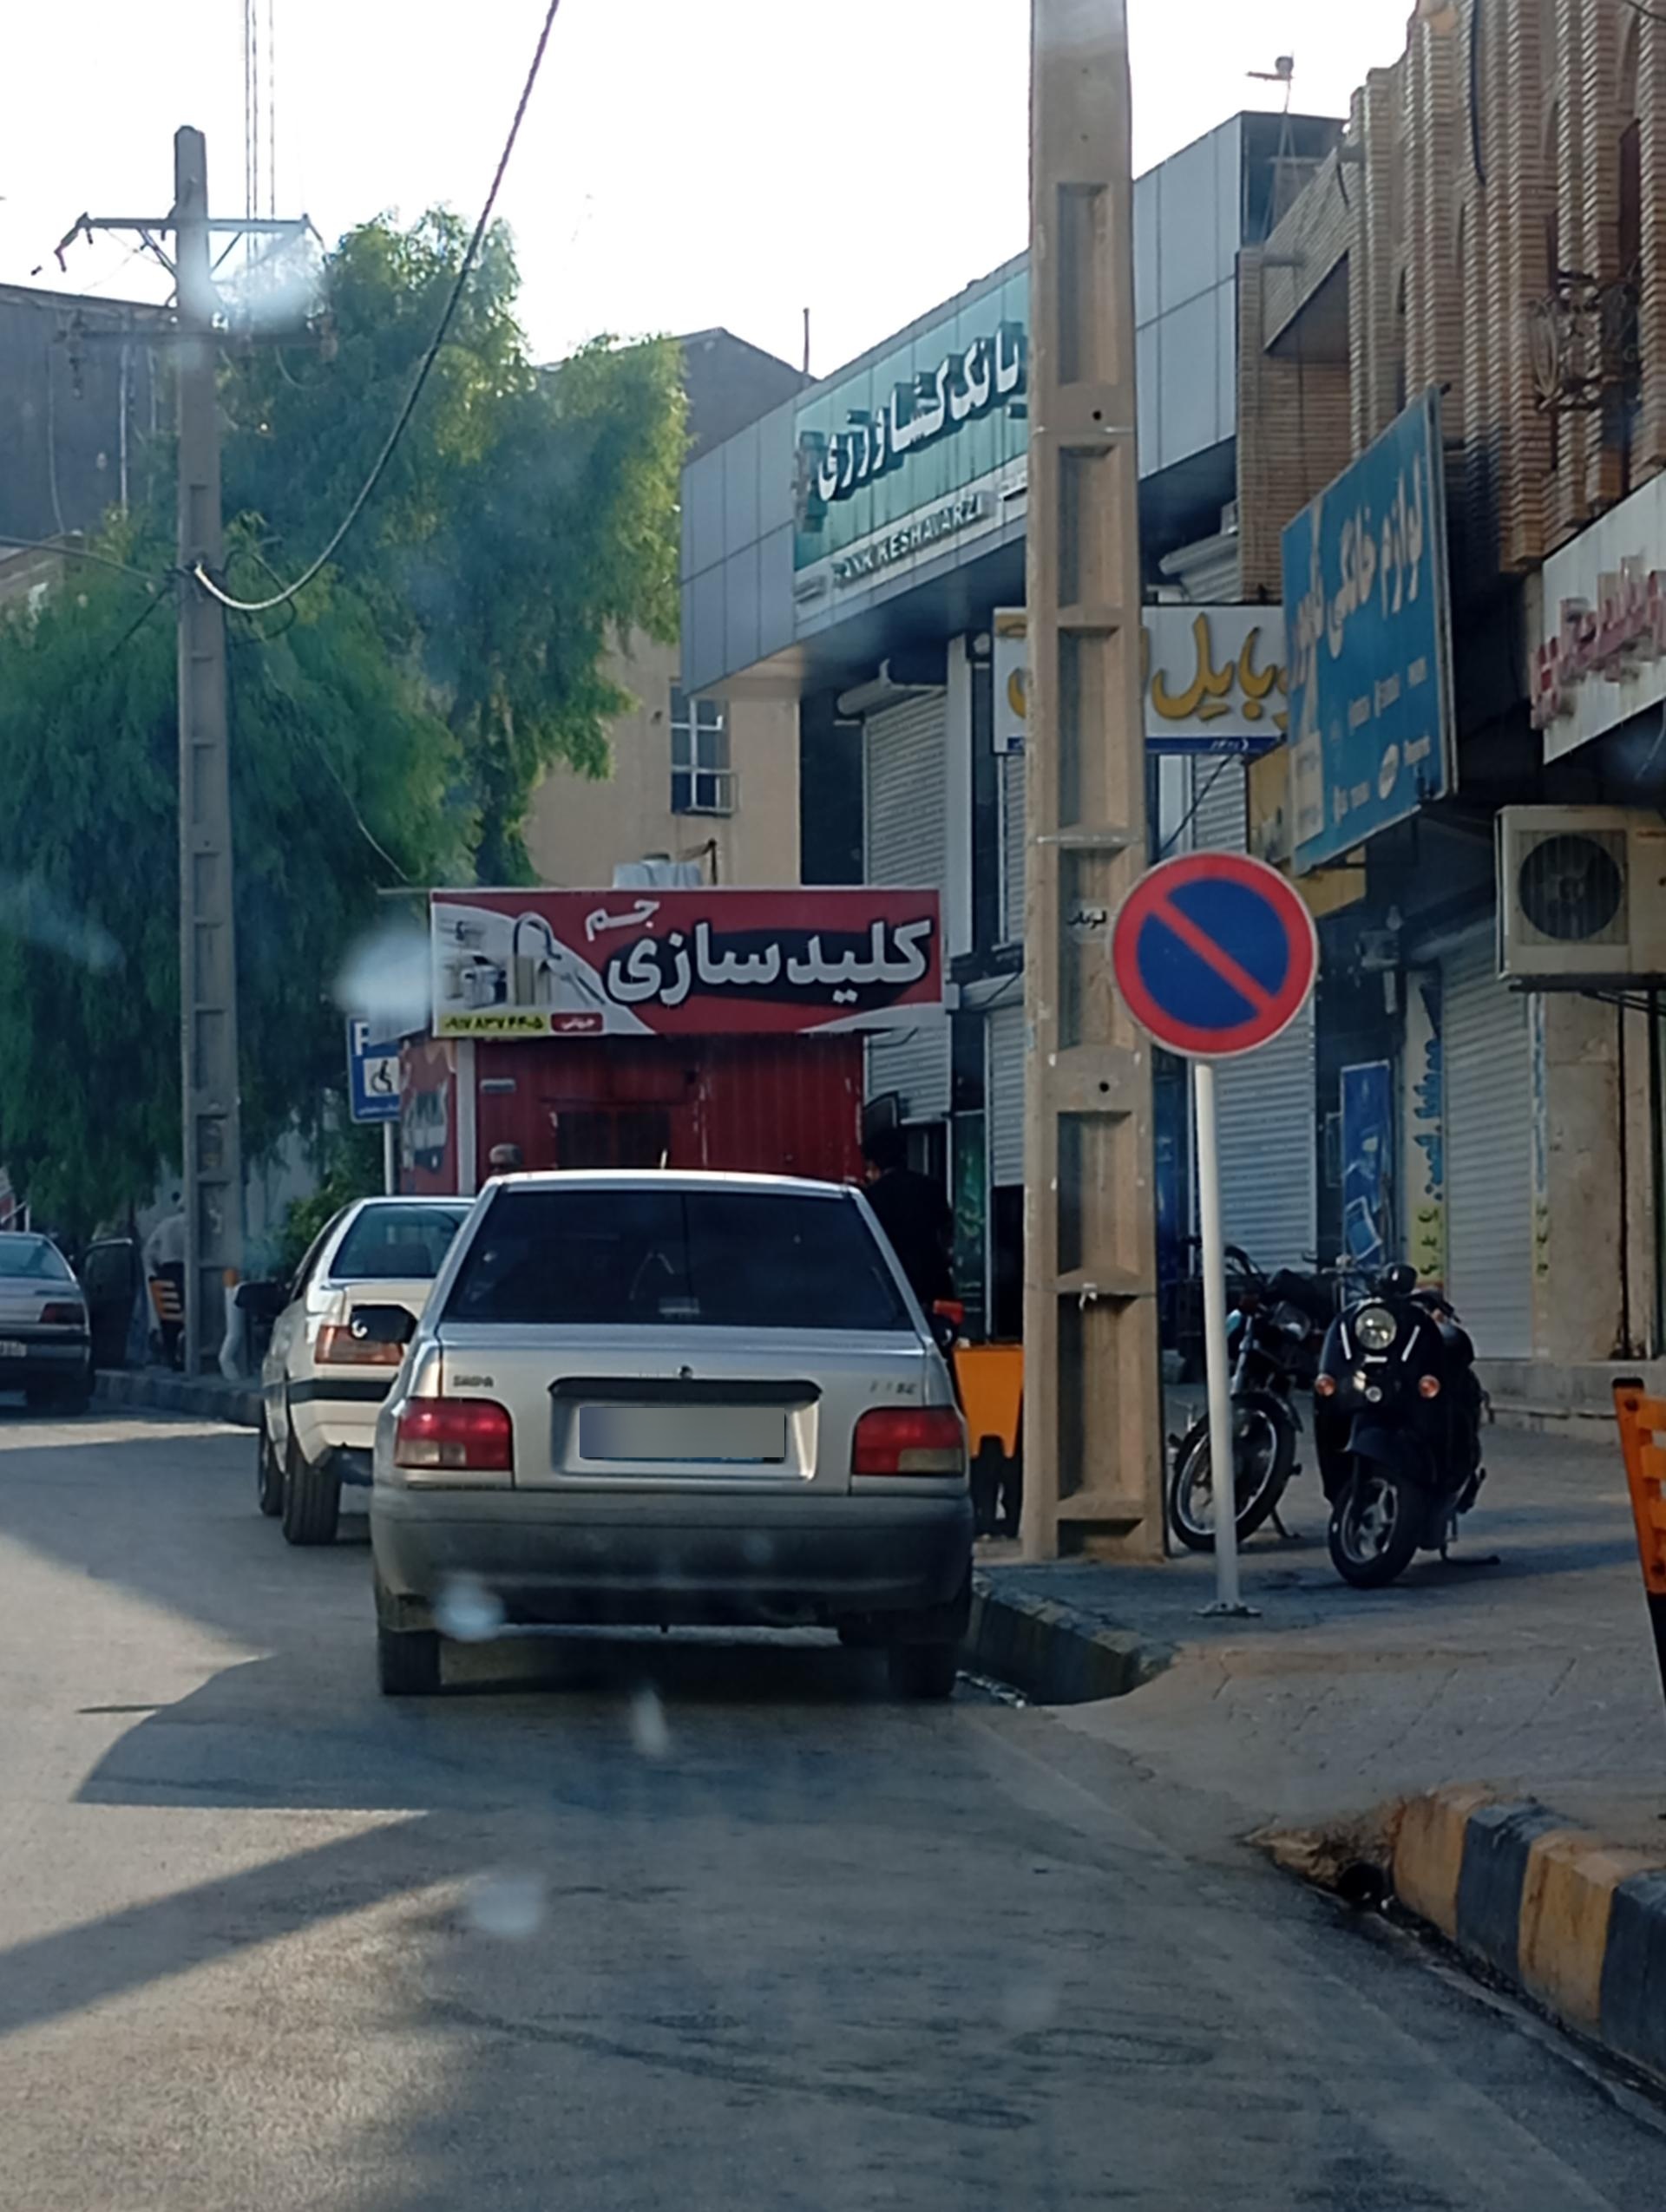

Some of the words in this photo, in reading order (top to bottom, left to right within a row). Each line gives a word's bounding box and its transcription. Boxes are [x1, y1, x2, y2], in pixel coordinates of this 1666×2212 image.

[817, 356, 949, 502] کشاورزی
[950, 326, 1022, 421] بانک
[1381, 451, 1424, 620] لوازم
[585, 897, 661, 942] جم
